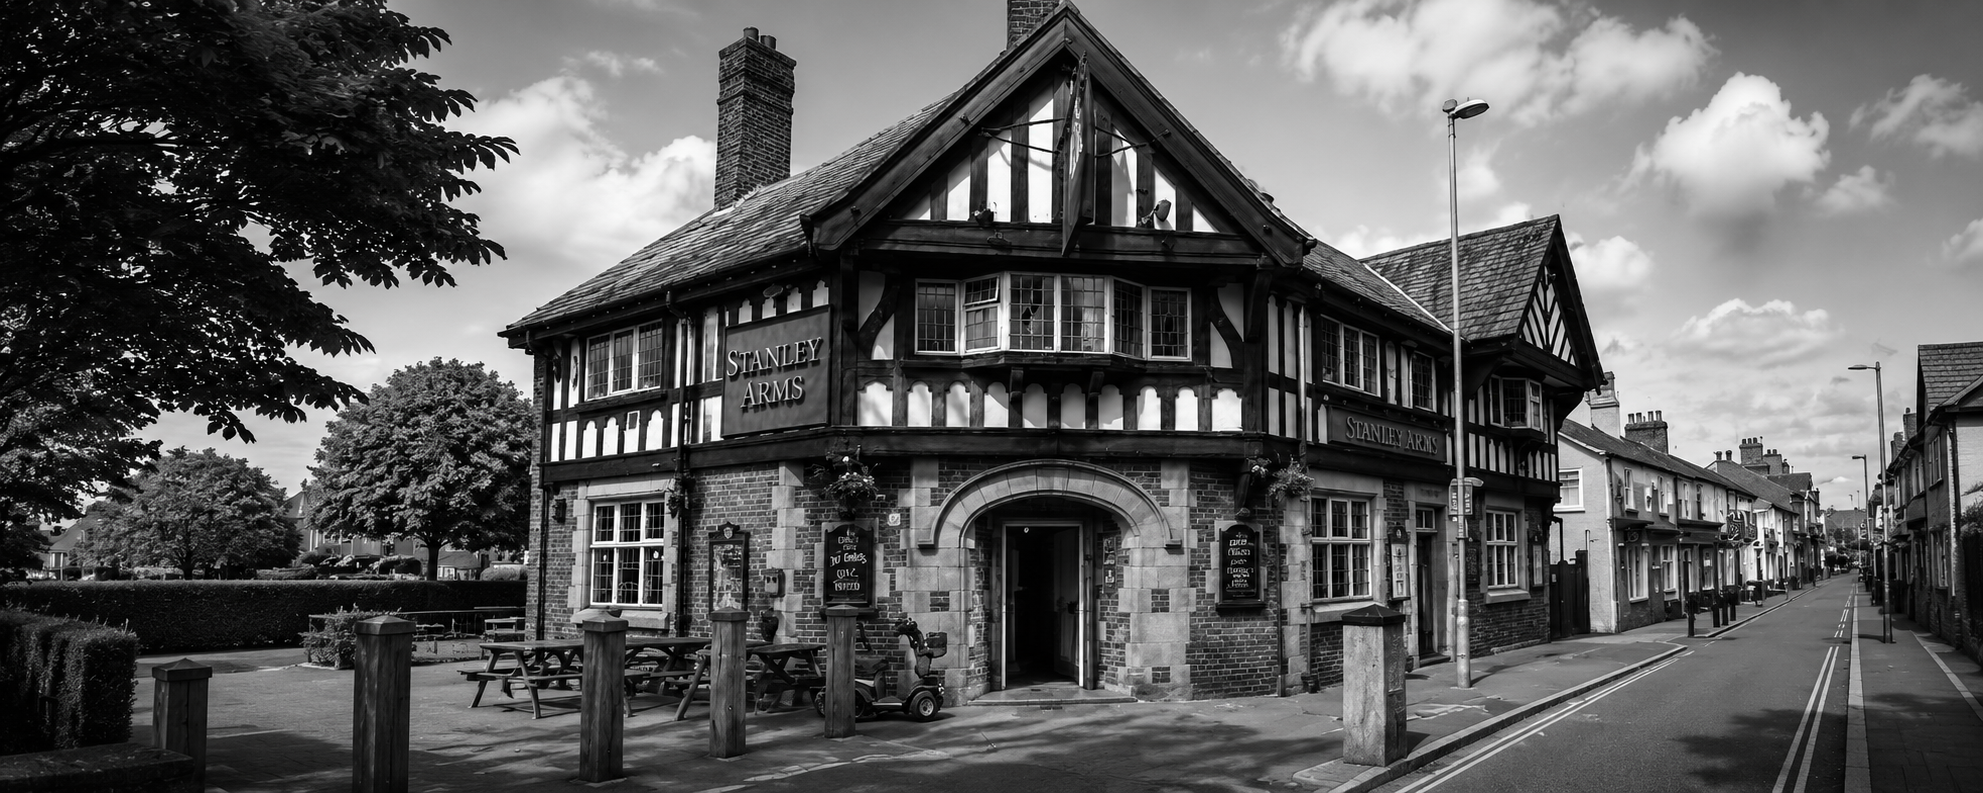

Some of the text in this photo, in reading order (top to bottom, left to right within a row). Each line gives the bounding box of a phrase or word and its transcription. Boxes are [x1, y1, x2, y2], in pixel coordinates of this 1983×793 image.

[726, 336, 822, 377] STANLEY
[740, 375, 804, 409] ARMS
[1345, 416, 1438, 455] STANLEY ARMS
